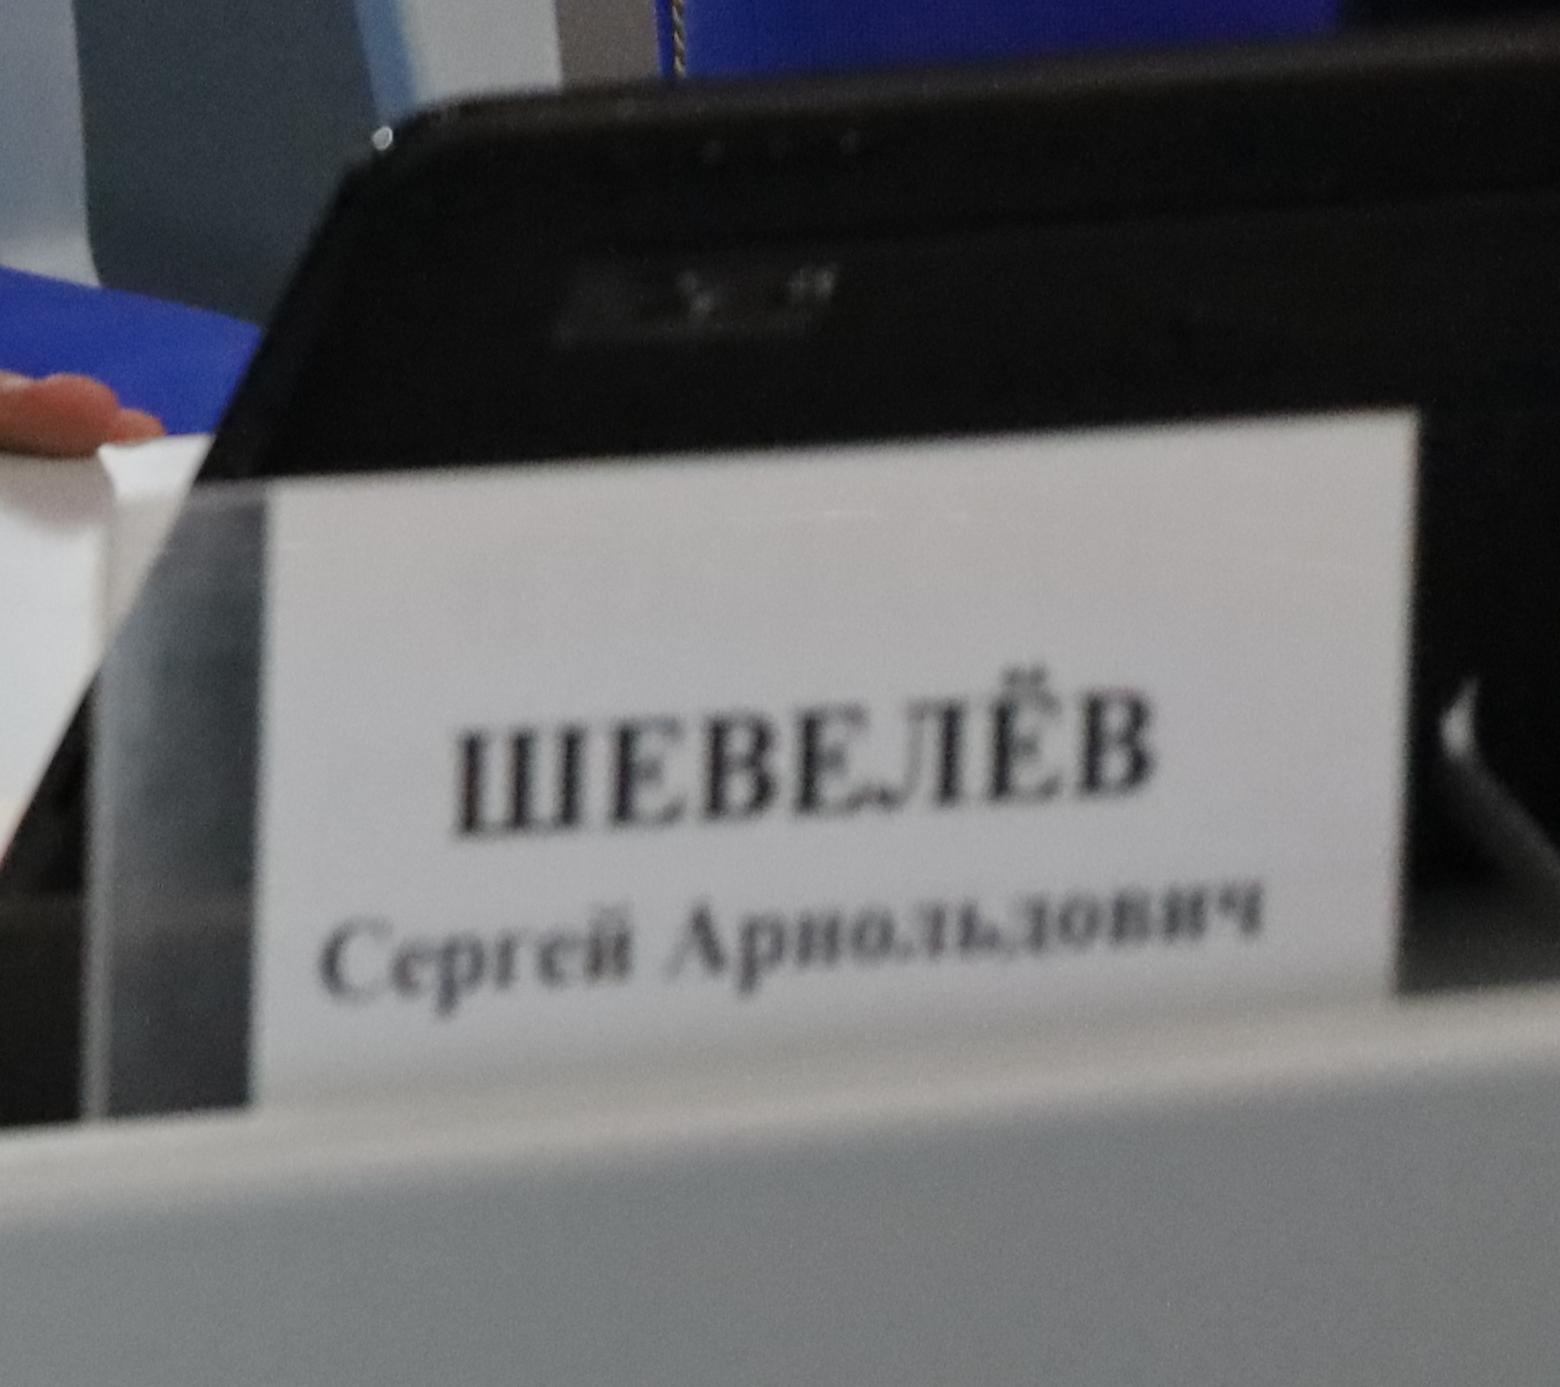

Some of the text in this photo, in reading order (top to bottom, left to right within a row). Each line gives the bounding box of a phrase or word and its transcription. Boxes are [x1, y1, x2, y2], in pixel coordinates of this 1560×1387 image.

[452, 664, 1158, 839] ШЕВЕЛЁВ
[320, 878, 1266, 1015] Сергей Арнольдович
